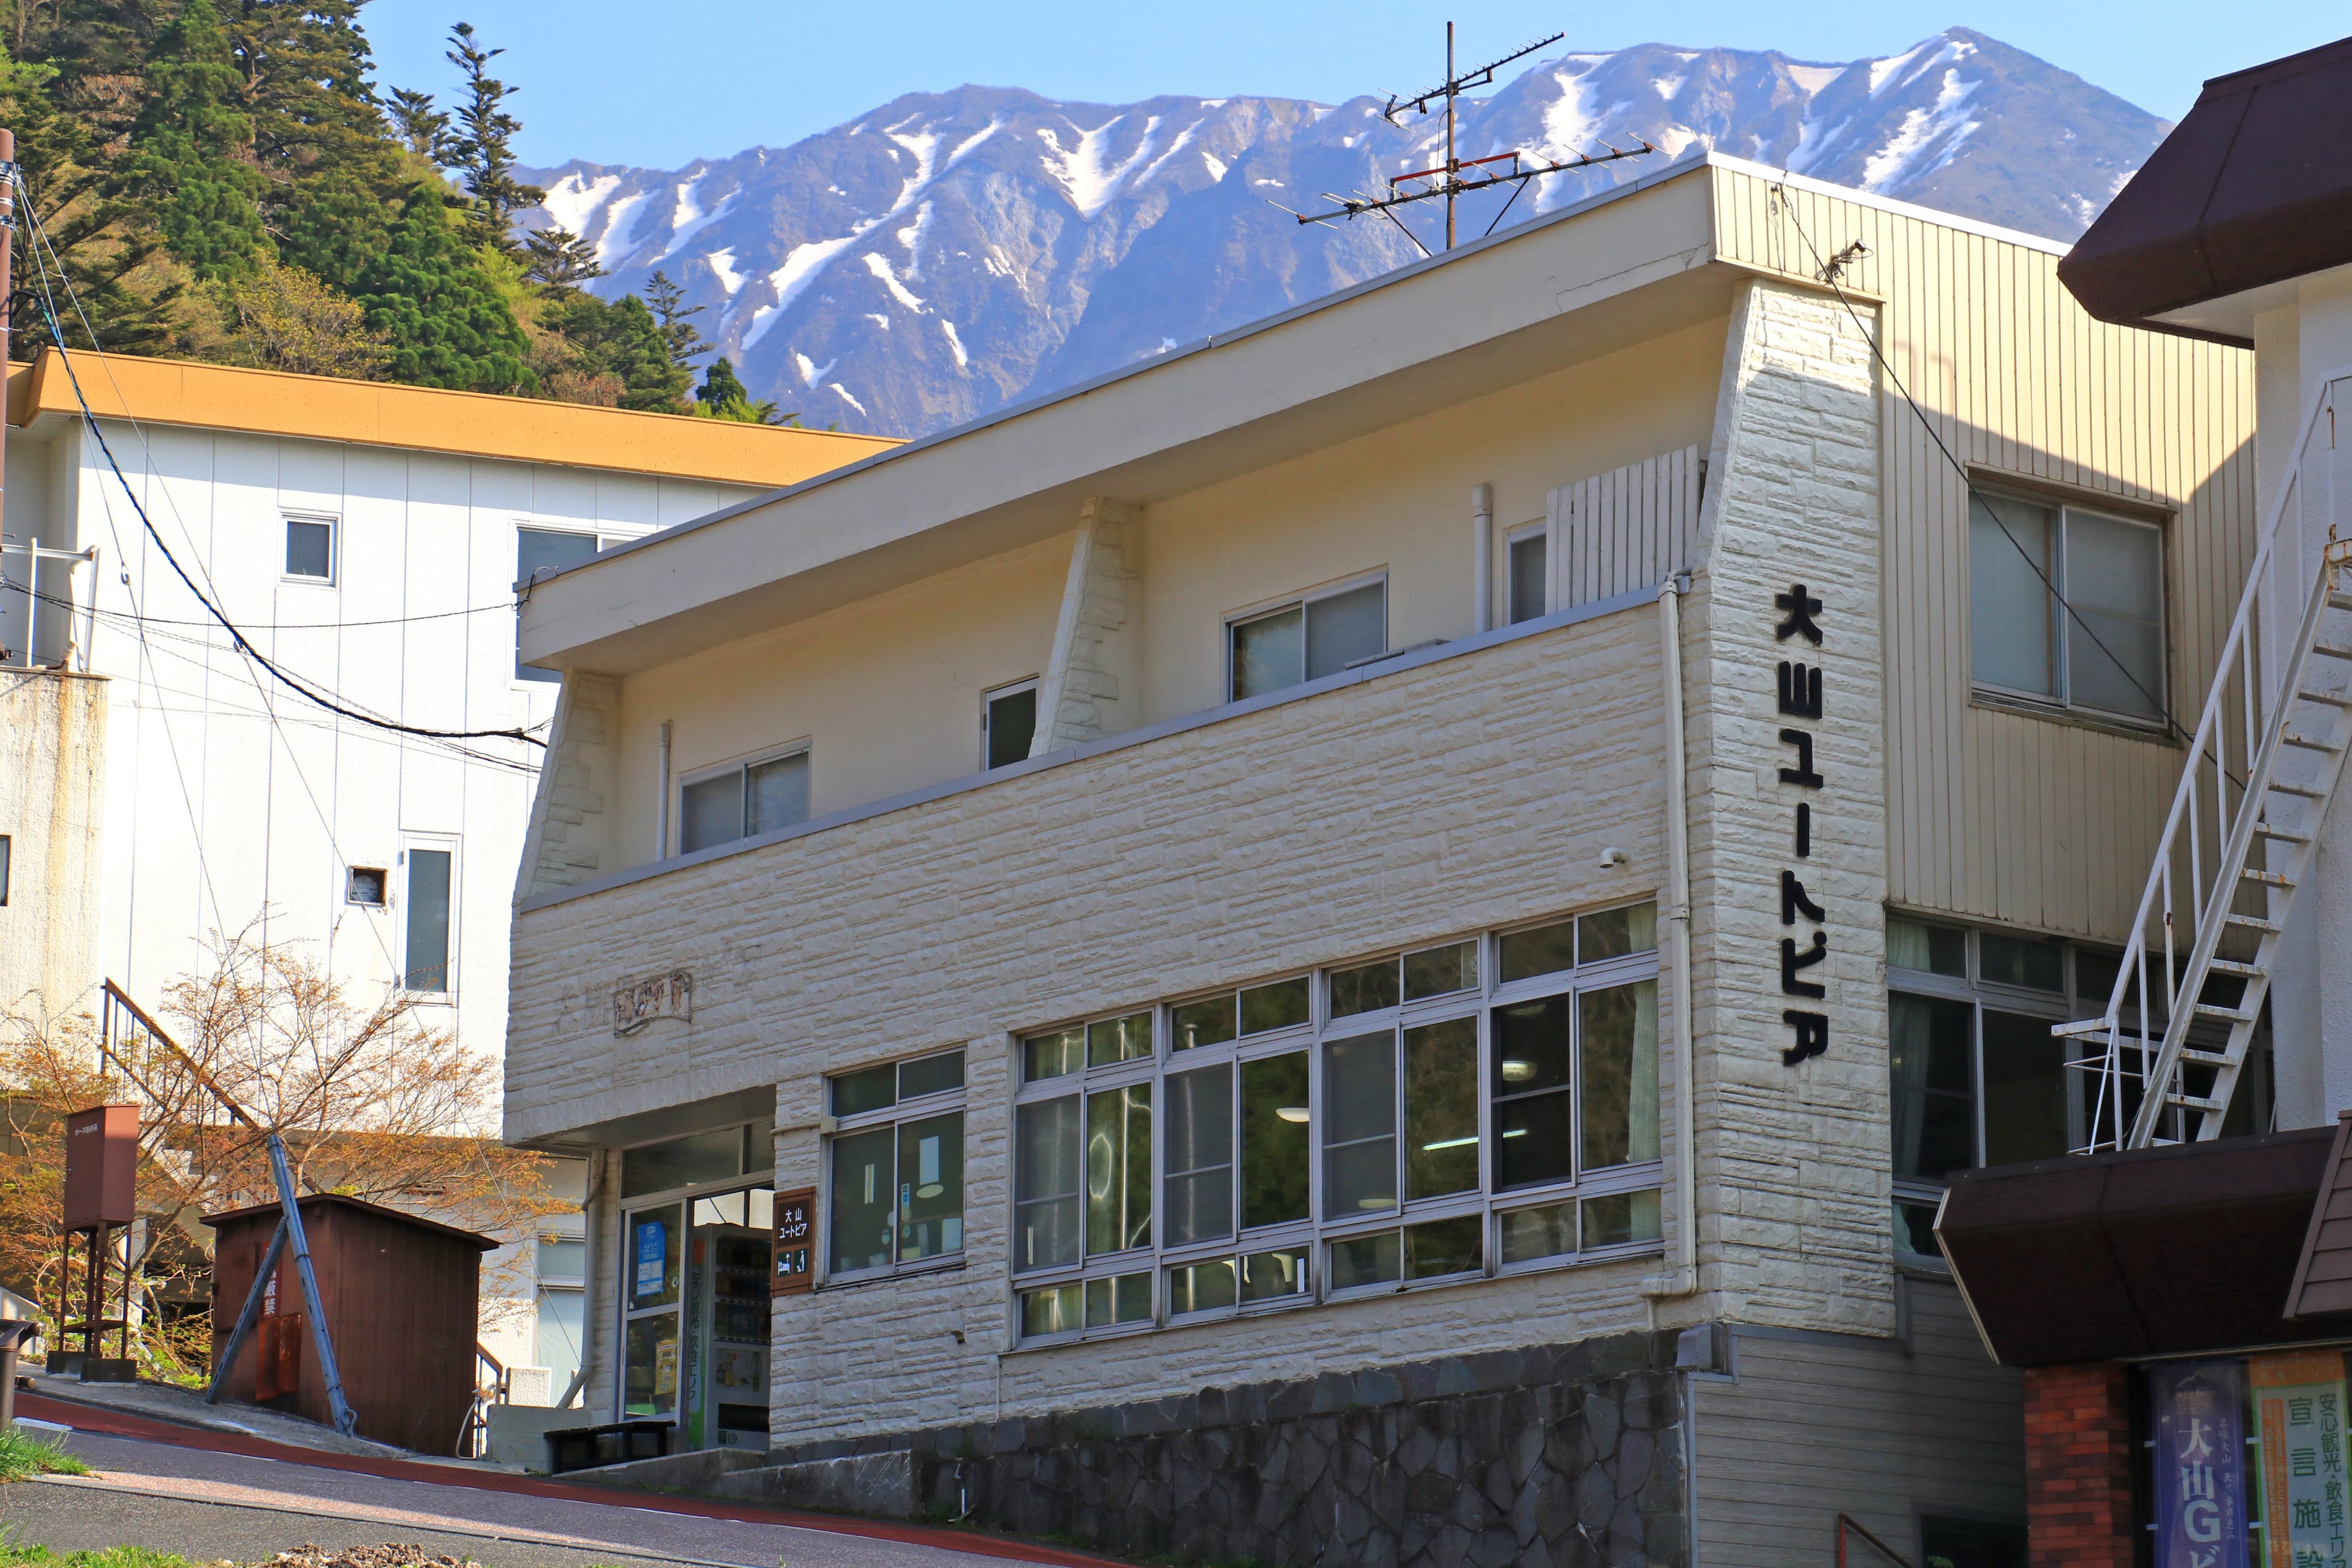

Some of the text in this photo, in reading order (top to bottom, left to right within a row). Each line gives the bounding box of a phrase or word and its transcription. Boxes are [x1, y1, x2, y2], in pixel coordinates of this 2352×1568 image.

[1775, 584, 1829, 1066] 大山ユートピア
[779, 1223, 808, 1238] ユートピア
[785, 1207, 802, 1223] 大山
[2288, 1396, 2323, 1568] 宣言施設
